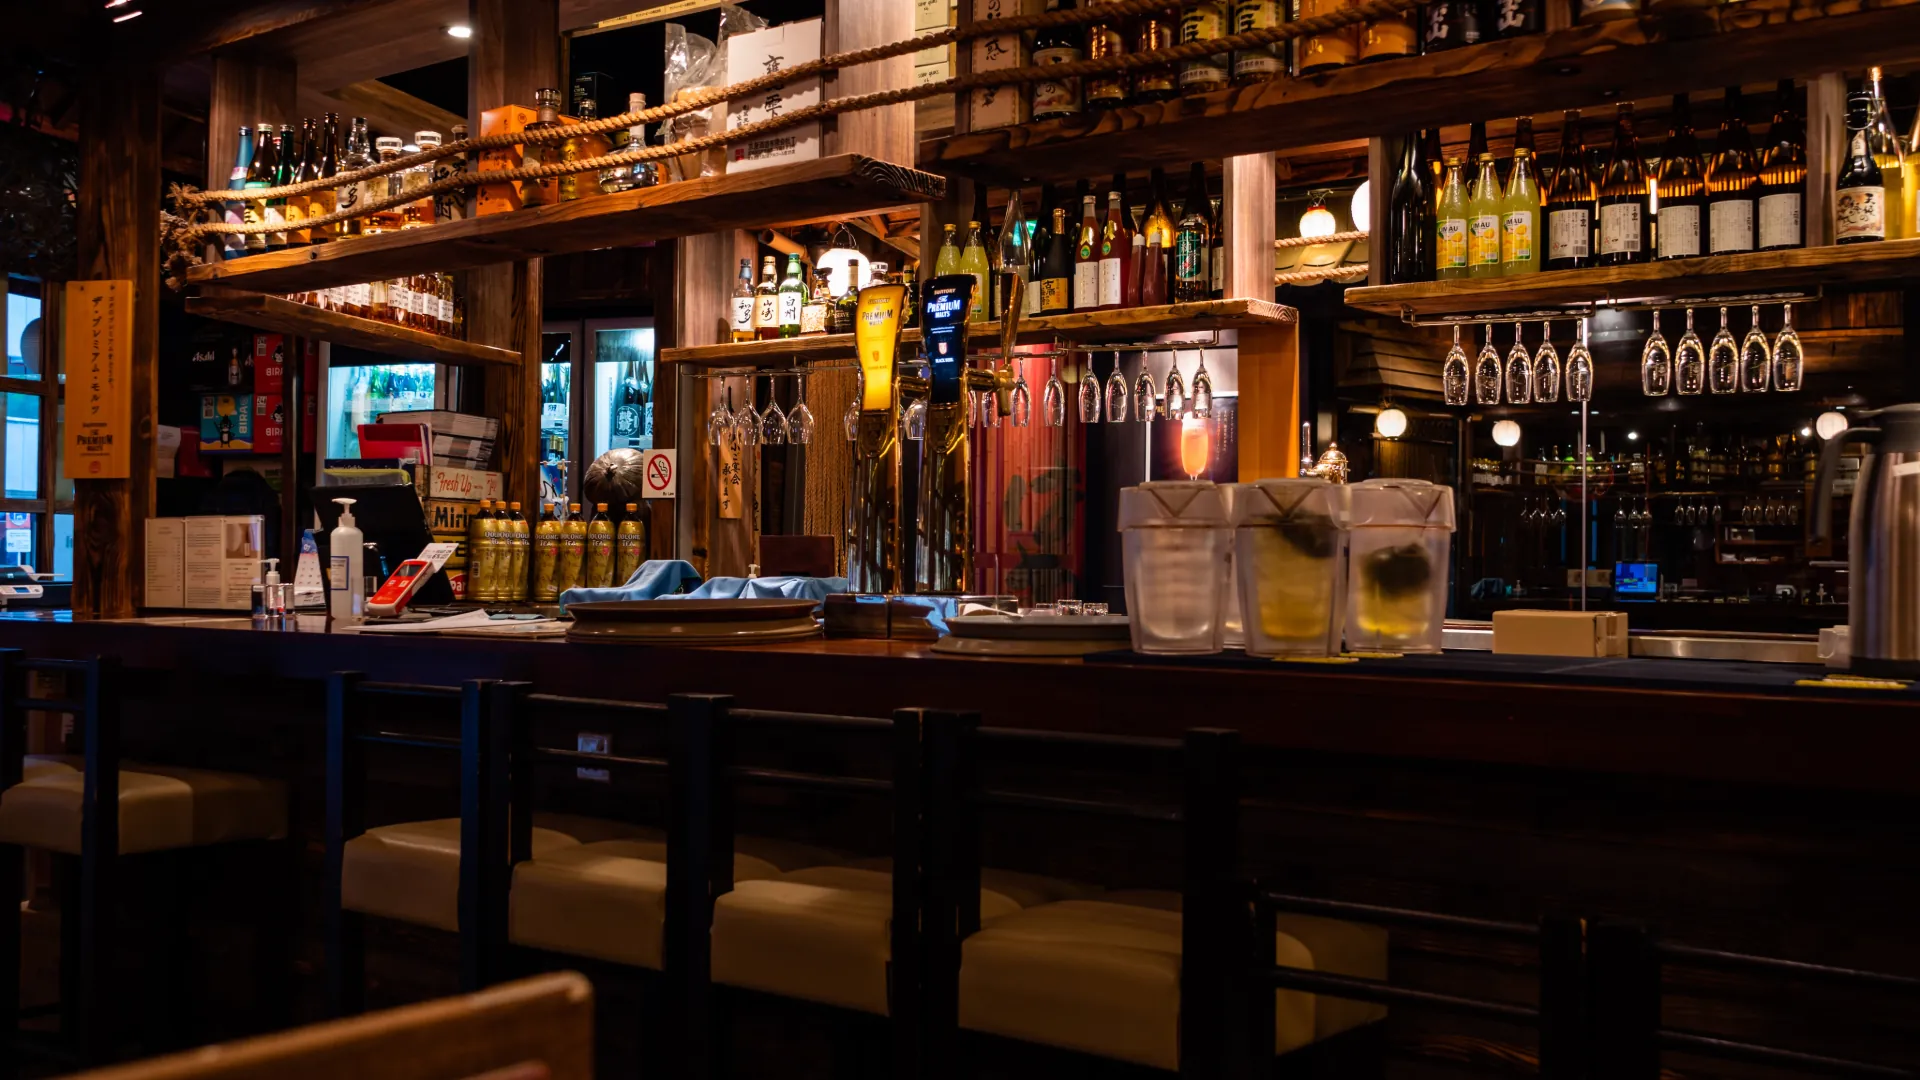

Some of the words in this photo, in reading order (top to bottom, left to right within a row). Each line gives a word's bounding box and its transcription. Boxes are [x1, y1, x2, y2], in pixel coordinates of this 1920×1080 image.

[785, 296, 796, 321] 白州
[927, 300, 961, 313] PREMIUM
[862, 309, 893, 320] PREMIUM
[192, 351, 215, 362] Asahi
[437, 472, 459, 492] Fresh
[460, 474, 472, 496] Up
